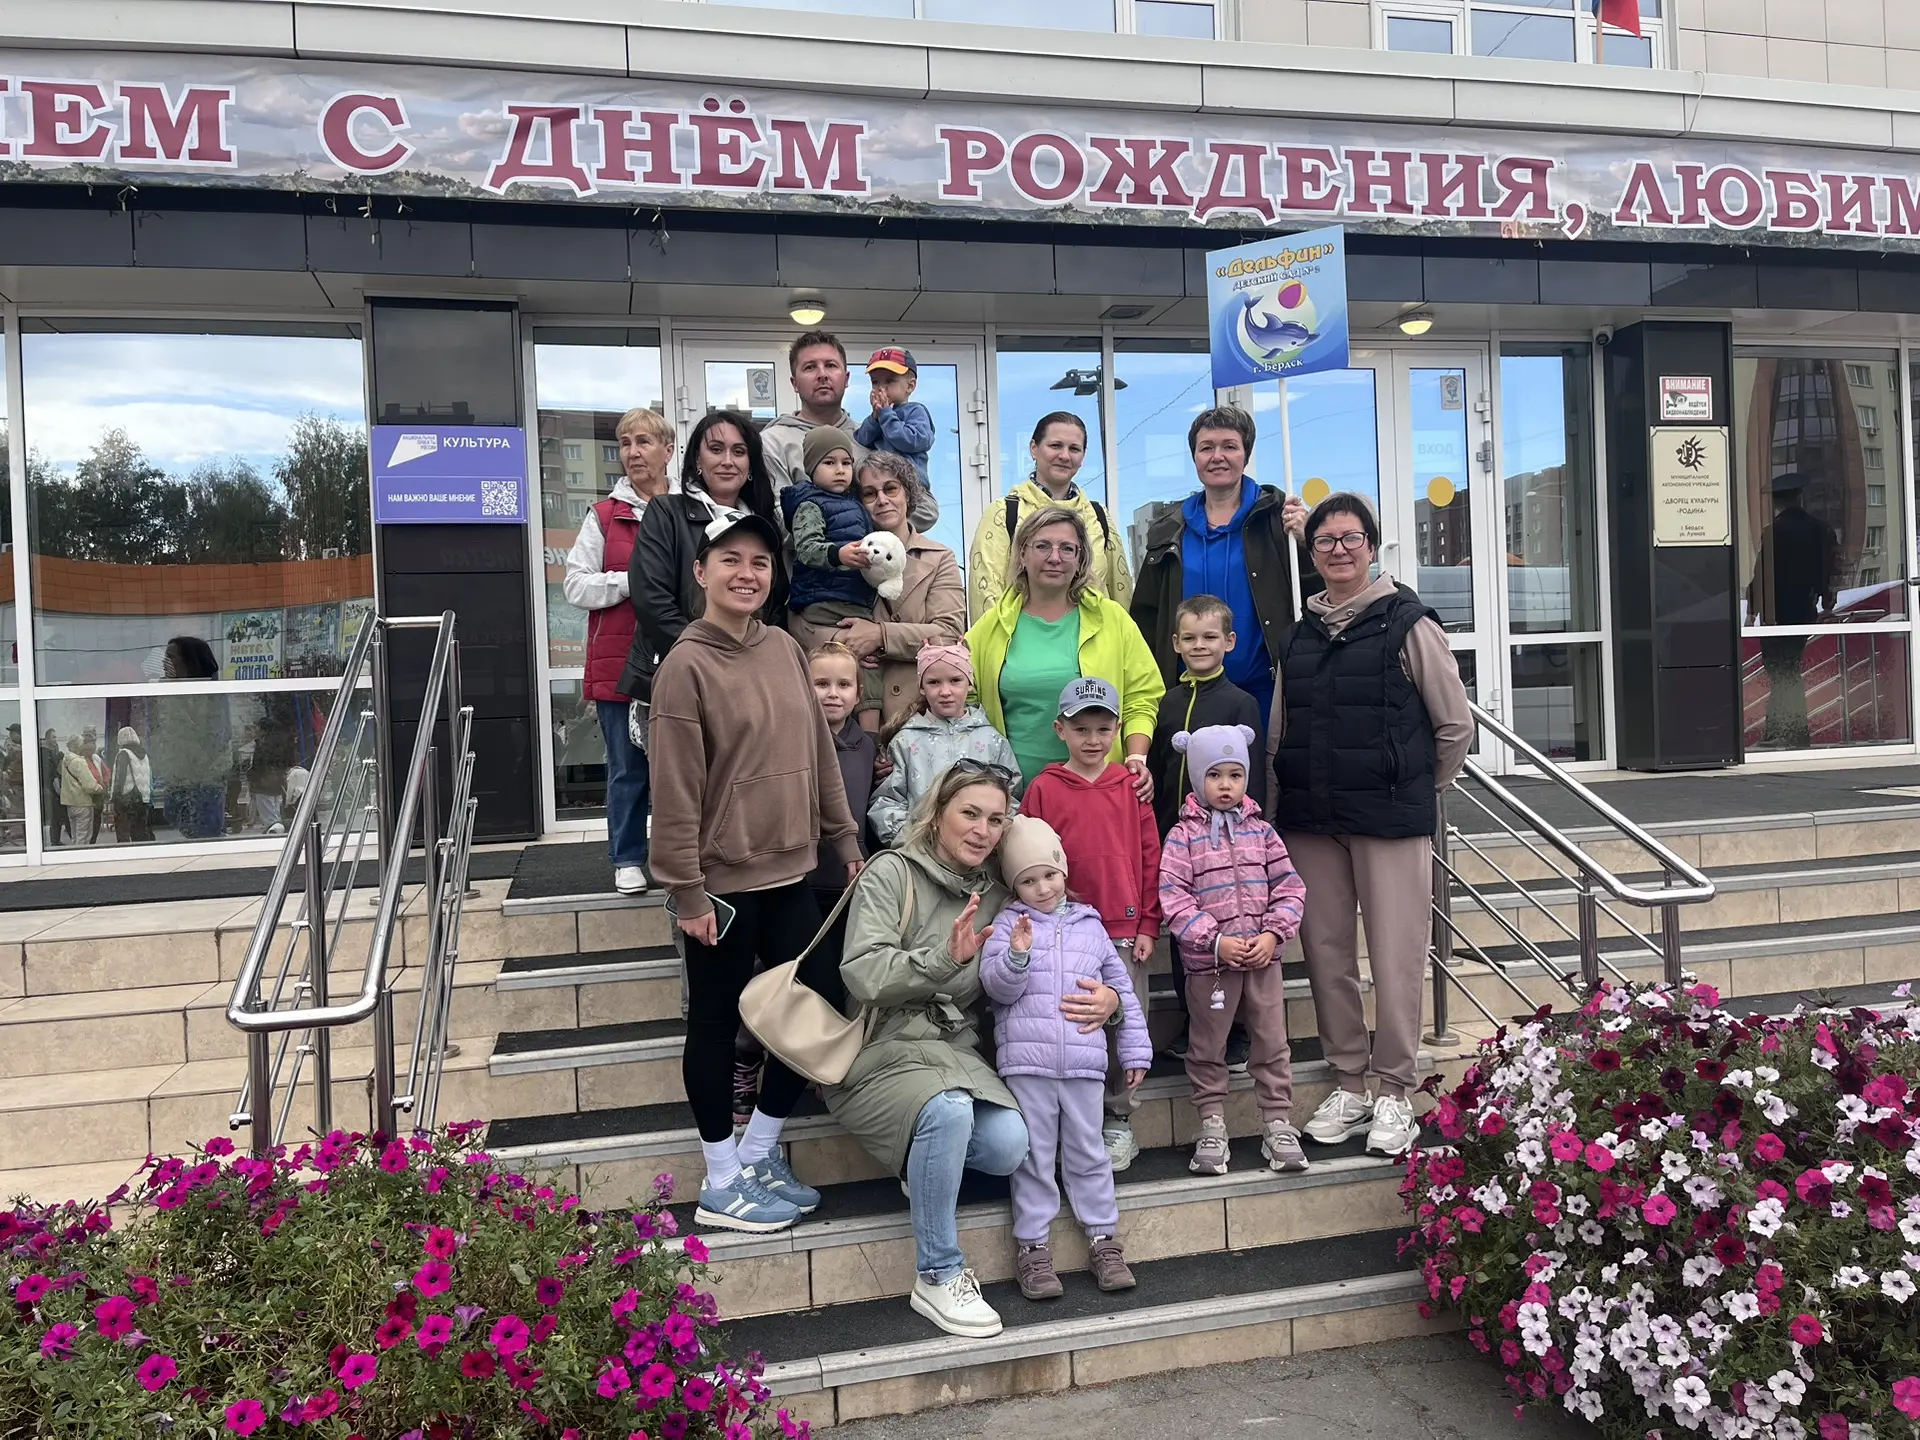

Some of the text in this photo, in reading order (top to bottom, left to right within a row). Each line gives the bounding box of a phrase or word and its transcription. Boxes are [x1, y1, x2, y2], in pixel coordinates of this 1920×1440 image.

[0, 78, 234, 166] ЕМ
[321, 92, 412, 171] С
[488, 96, 868, 193] ДНЁМ
[938, 127, 1586, 236] РОЖДЕНИЯ,
[1216, 243, 1334, 278] «Дельфин»
[1253, 359, 1303, 374] г. Бердск
[1665, 379, 1706, 390] ВНИМАНИЕ
[443, 437, 511, 449] КУЛЬТУРА
[387, 494, 476, 502] НАМ ВАЖНО ВАШЕ МНЕНИЕ
[1076, 684, 1106, 697] SURFING
